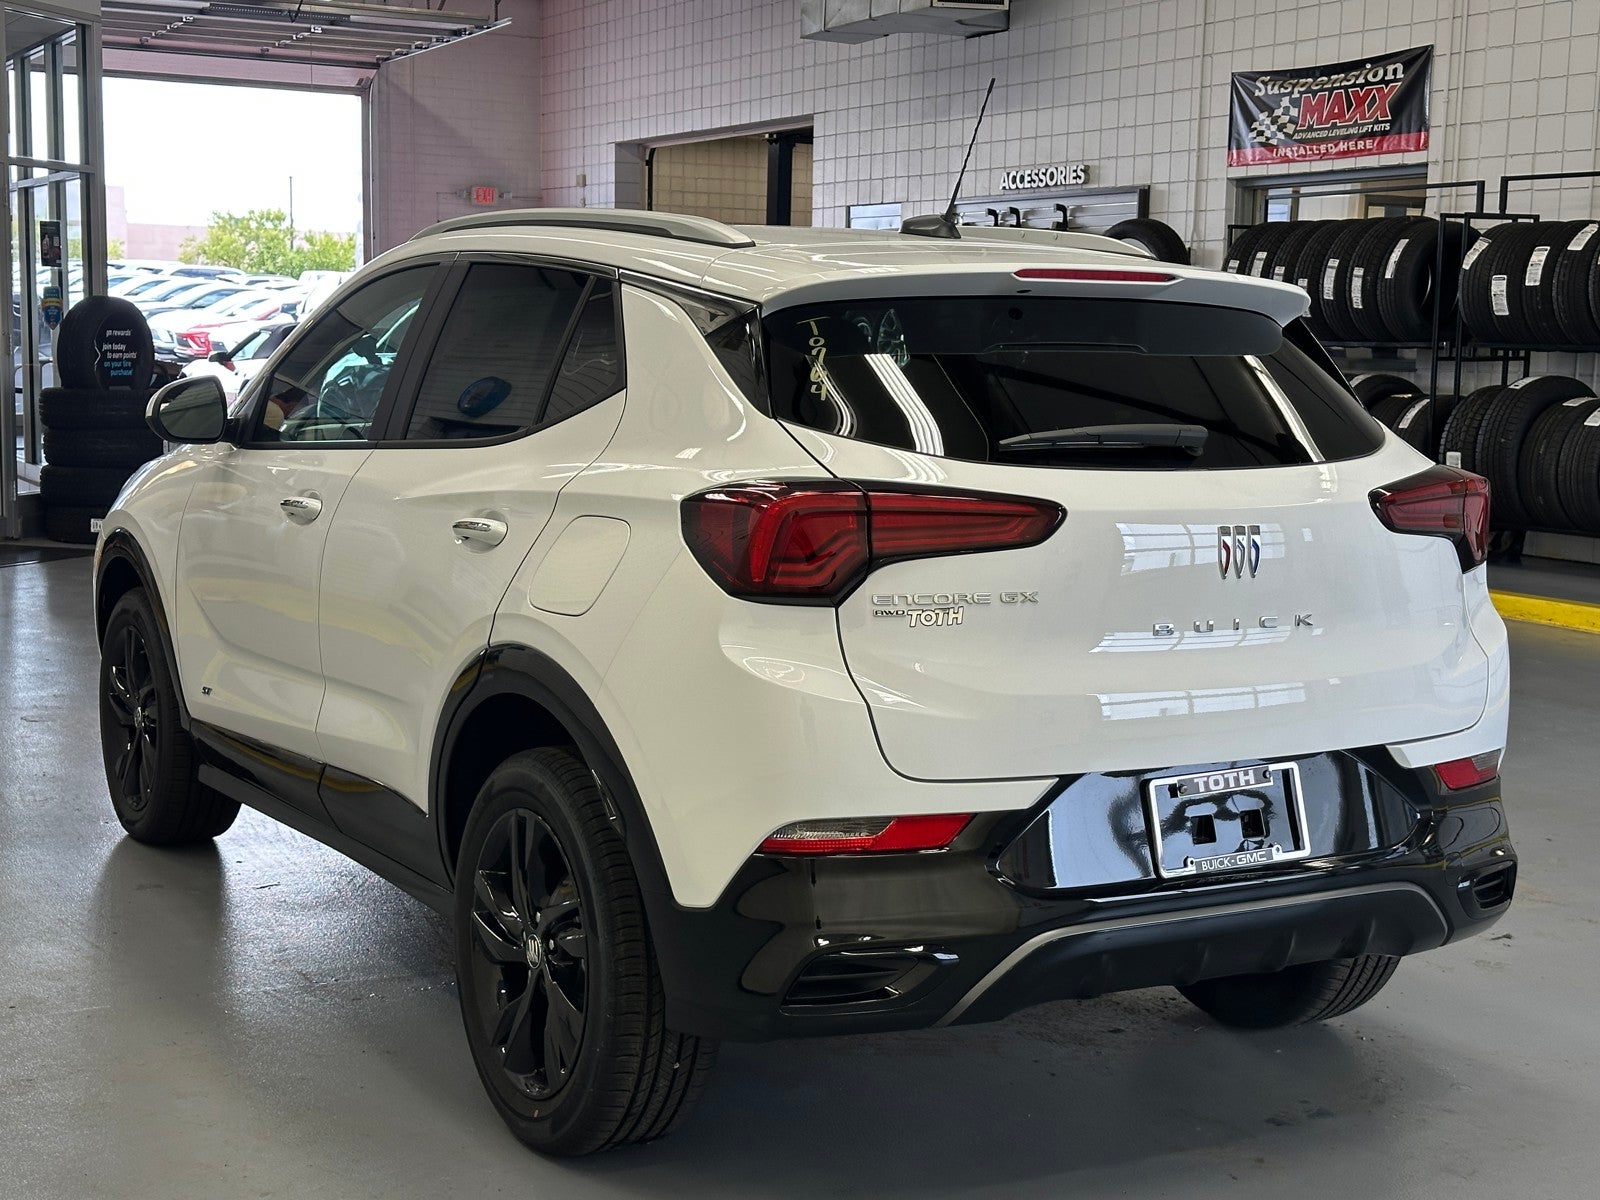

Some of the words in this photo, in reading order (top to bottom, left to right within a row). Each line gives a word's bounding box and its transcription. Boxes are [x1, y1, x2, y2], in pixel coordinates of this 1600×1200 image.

[1254, 62, 1404, 97] Suspension
[1297, 82, 1402, 130] MAXX
[1293, 130, 1327, 140] ADVANCED
[1328, 127, 1358, 137] LEVELING
[1359, 124, 1373, 134] LIFT
[1373, 122, 1390, 132] KITS
[1273, 143, 1335, 157] INSTALLED
[1341, 139, 1374, 151] HERE
[1000, 165, 1085, 190] ACCESSORIES
[102, 343, 112, 351] join
[112, 343, 126, 351] today
[111, 361, 121, 369] your
[872, 592, 991, 606] ENCORE
[1000, 591, 1039, 604] GX
[907, 606, 964, 627] TOTH
[1153, 614, 1313, 636] BUICK
[1194, 770, 1255, 792] TOTH
[1202, 858, 1231, 871] BUICK
[1236, 851, 1267, 865] GMC
